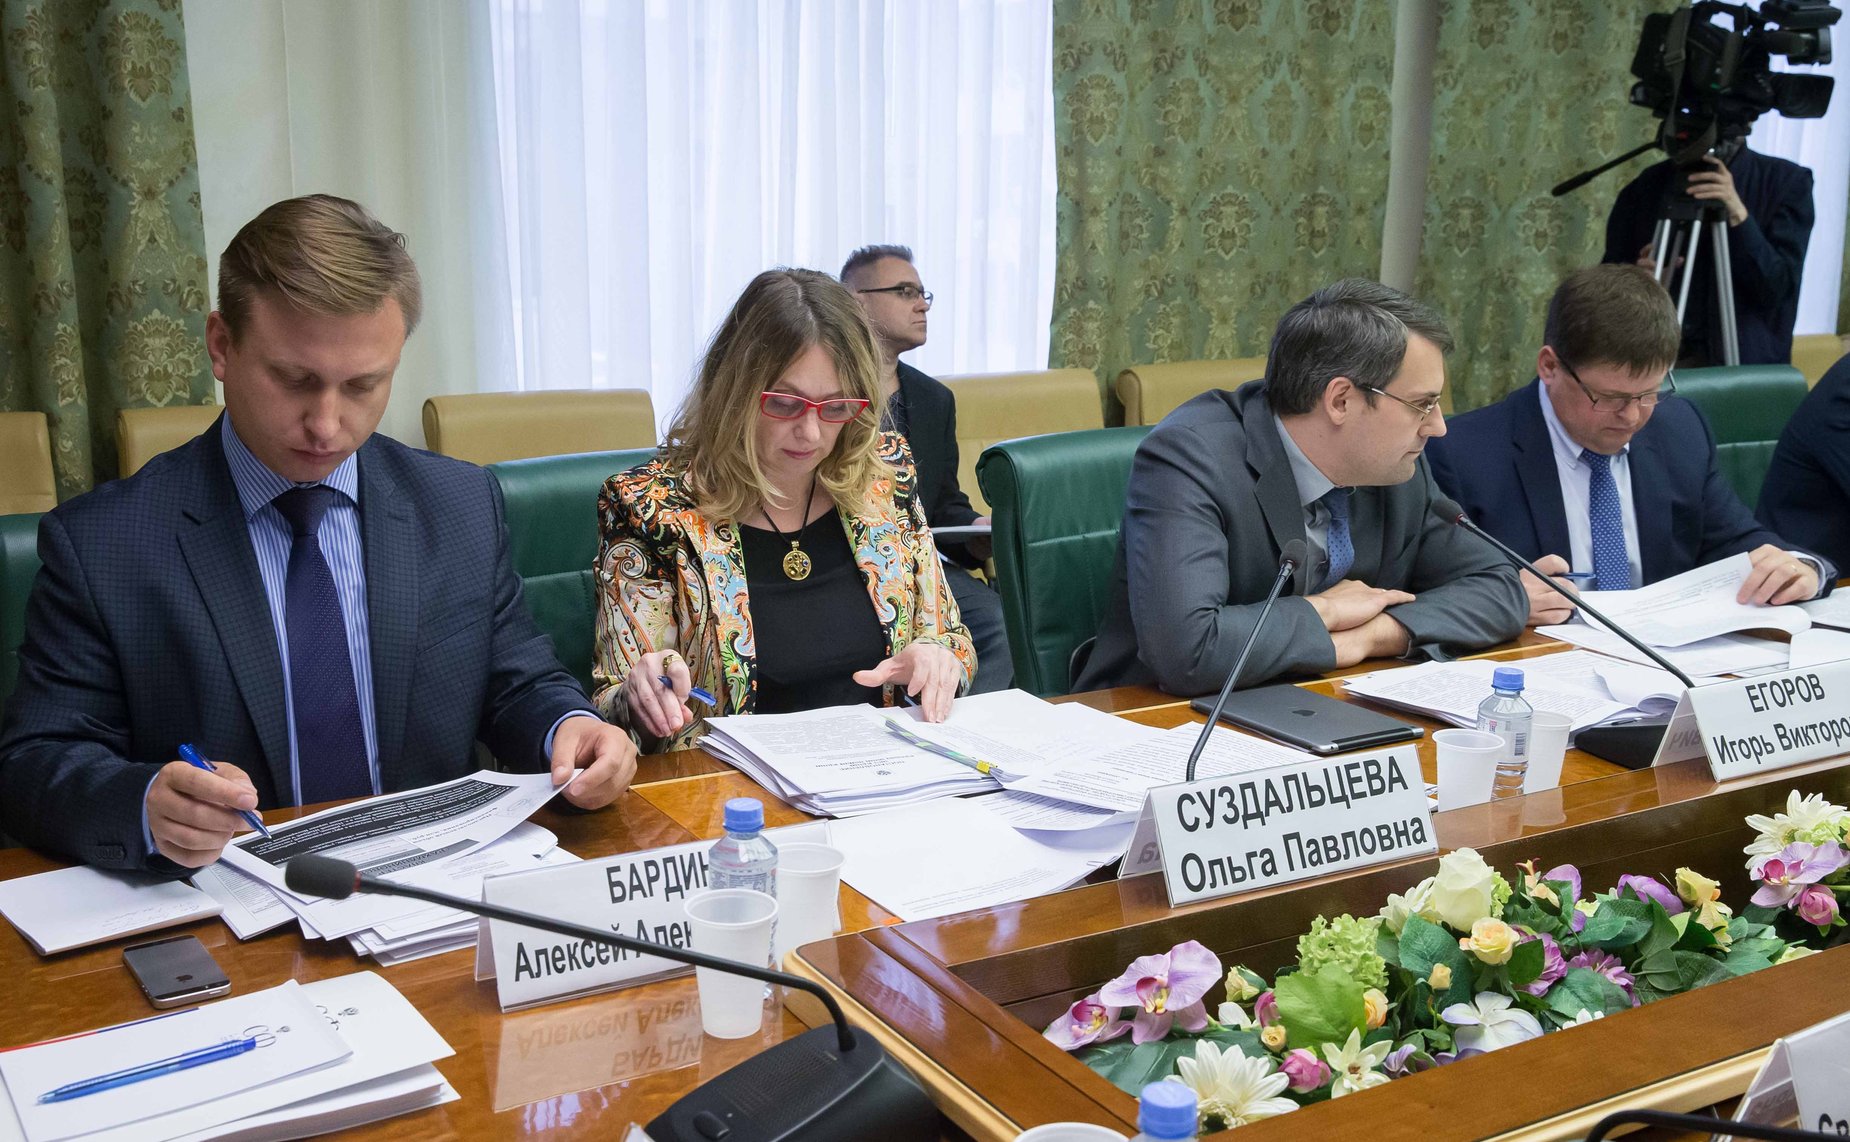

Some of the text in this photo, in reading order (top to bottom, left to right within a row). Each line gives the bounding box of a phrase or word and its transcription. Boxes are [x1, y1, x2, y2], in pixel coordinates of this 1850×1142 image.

[1745, 673, 1826, 713] ЕГОРОВ
[1712, 734, 1776, 765] Игорь
[1773, 716, 1850, 752] Викторо
[1176, 755, 1409, 833] СУЗДАЛЬЦЕВА
[1180, 847, 1278, 893] Ольга
[1282, 816, 1428, 872] Павловна
[514, 922, 628, 982] Алексей
